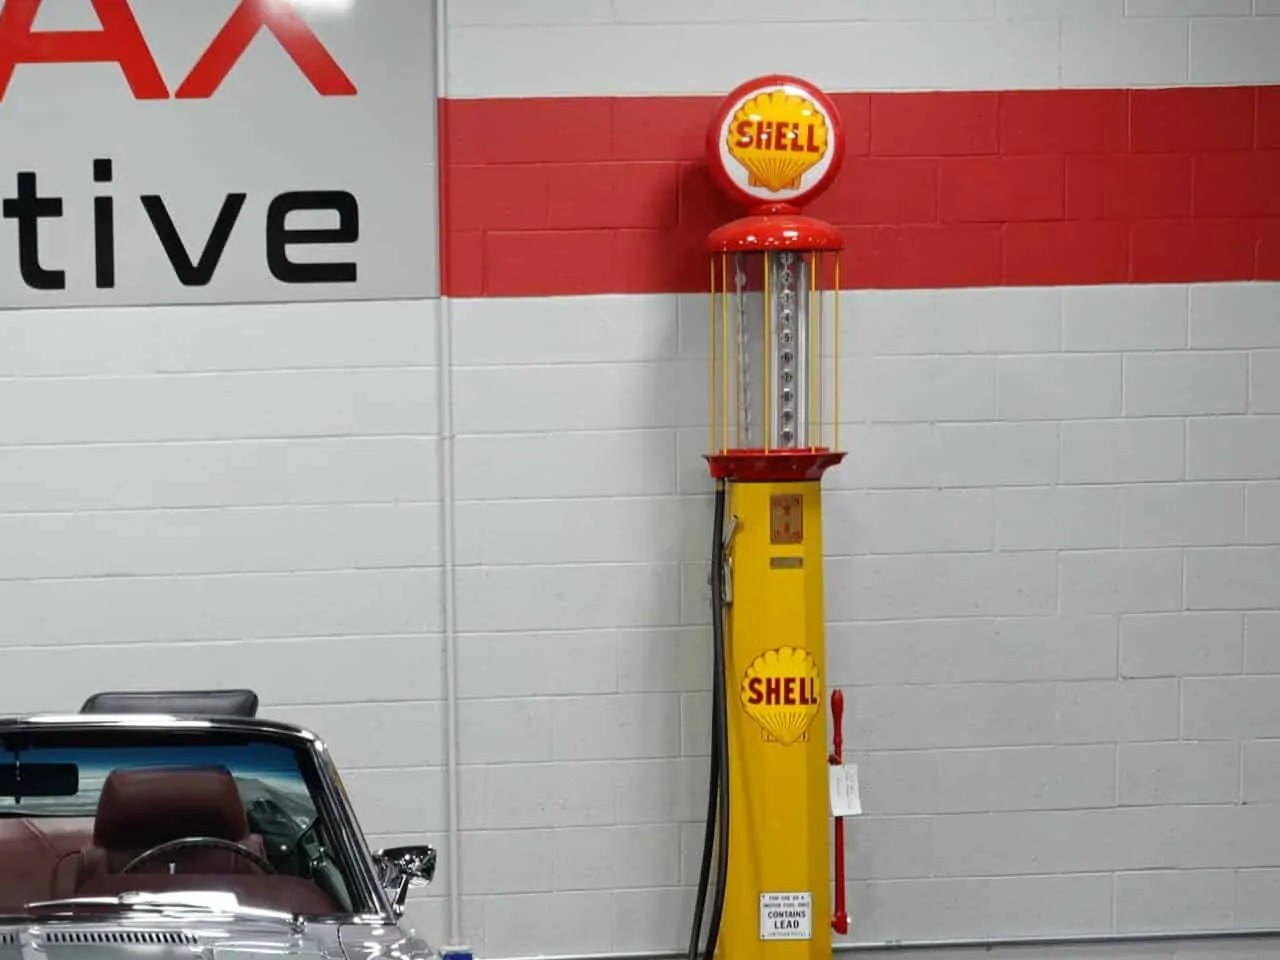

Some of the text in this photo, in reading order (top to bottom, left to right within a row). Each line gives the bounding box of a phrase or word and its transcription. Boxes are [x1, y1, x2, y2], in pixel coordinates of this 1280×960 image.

[735, 120, 820, 153] SHELL
[748, 676, 818, 706] SHELL
[767, 910, 806, 919] CONTAINS
[774, 920, 800, 930] LEAD
